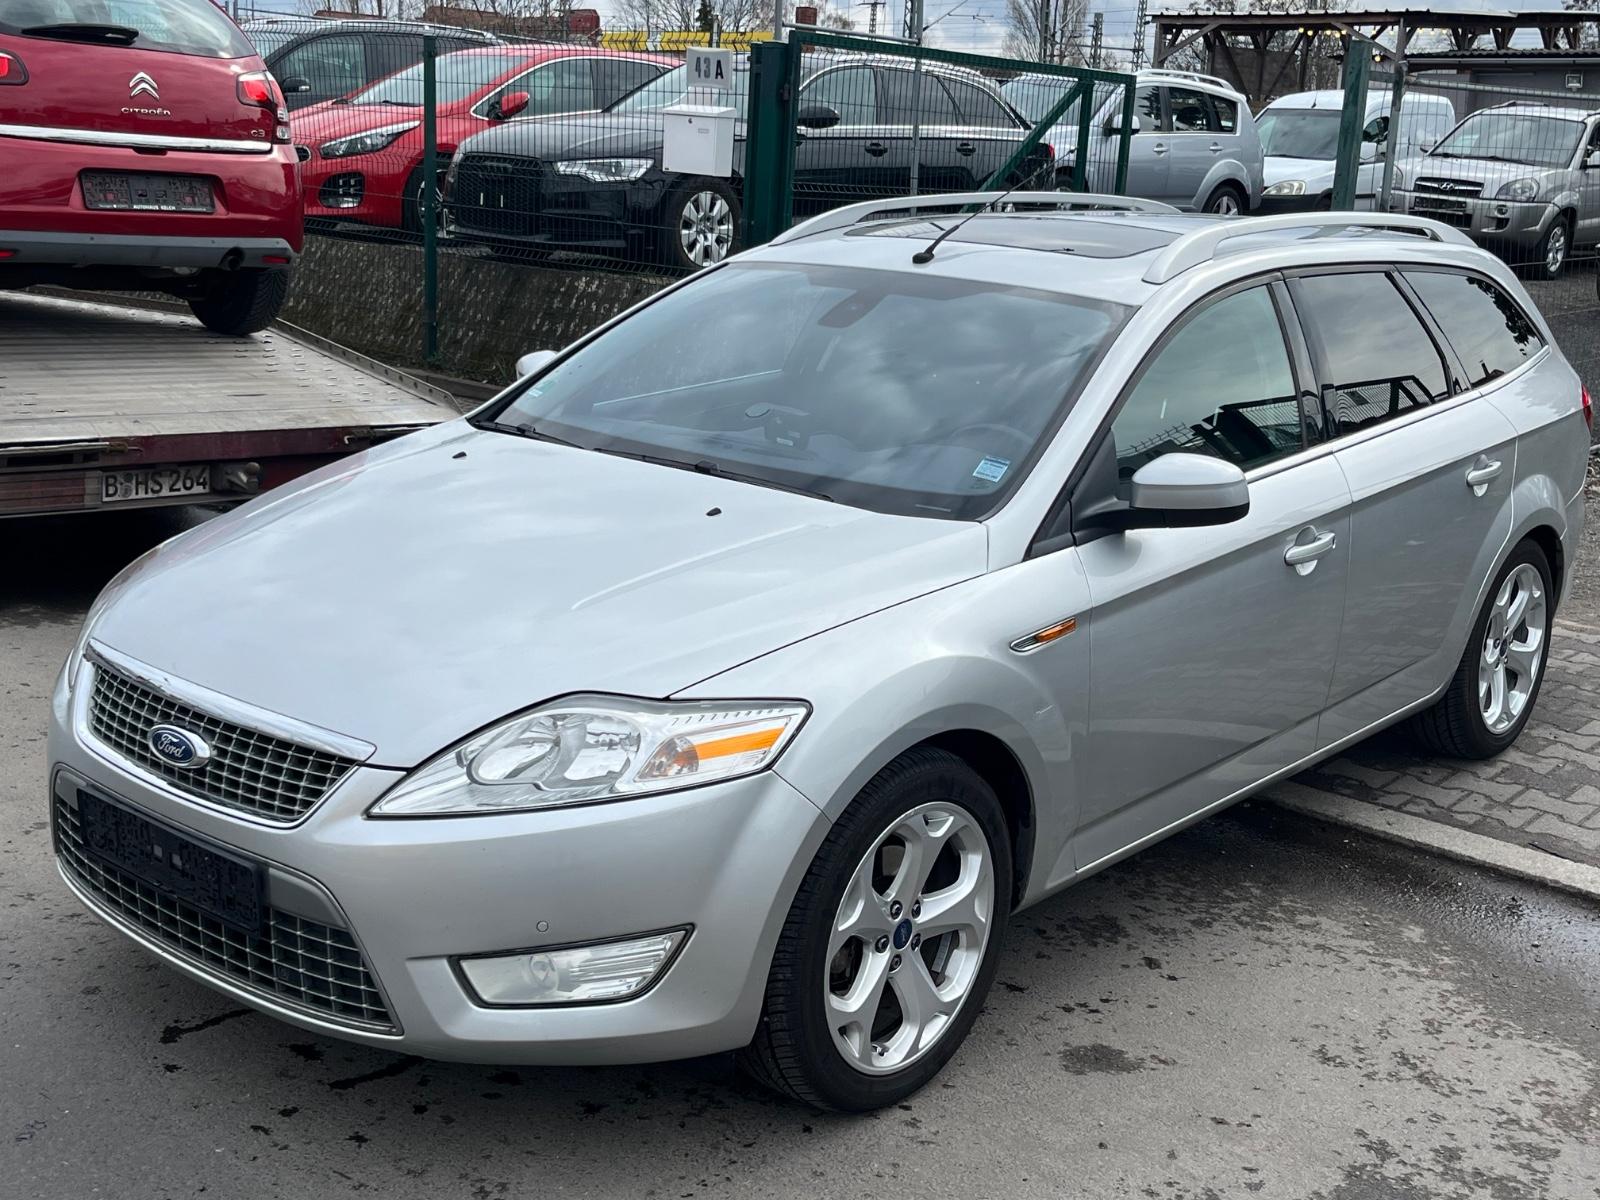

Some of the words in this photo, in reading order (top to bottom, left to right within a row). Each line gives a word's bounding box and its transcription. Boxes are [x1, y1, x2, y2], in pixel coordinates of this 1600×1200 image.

[694, 56, 711, 79] 43
[715, 60, 724, 79] A
[250, 129, 266, 138] C3
[105, 474, 119, 498] B
[135, 468, 163, 495] HS
[168, 467, 208, 492] 264
[157, 734, 186, 759] Ford
